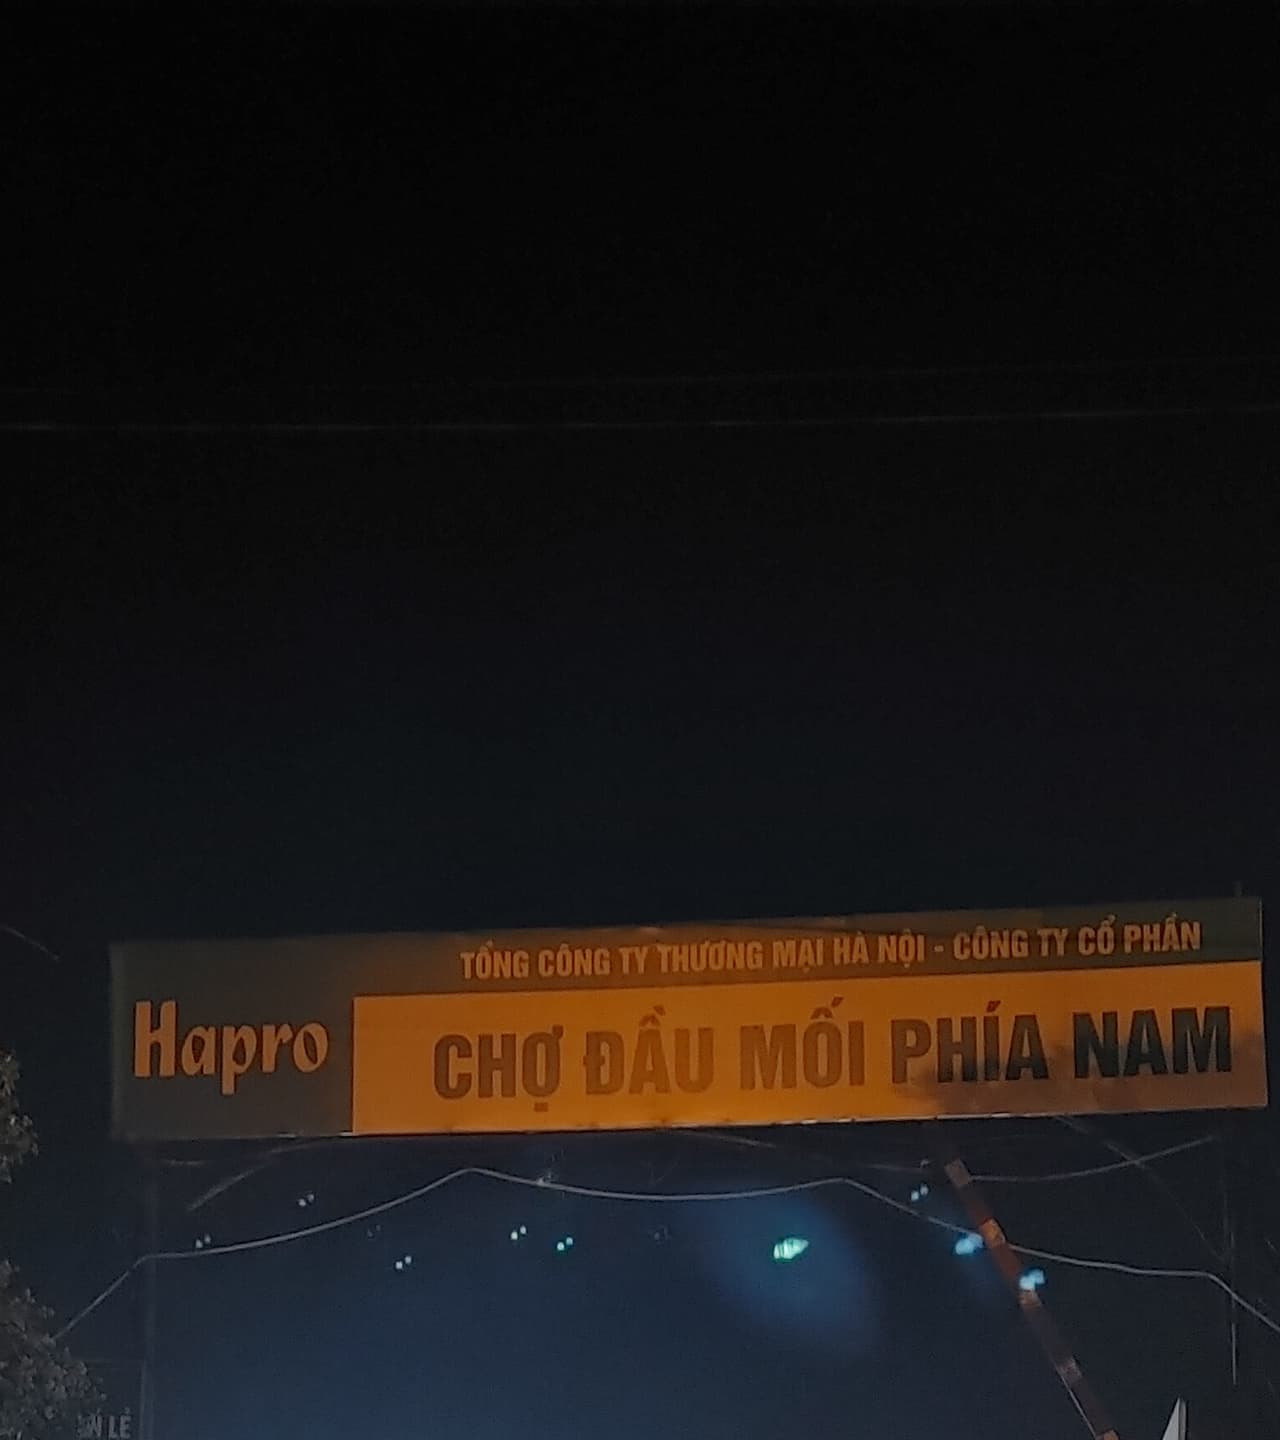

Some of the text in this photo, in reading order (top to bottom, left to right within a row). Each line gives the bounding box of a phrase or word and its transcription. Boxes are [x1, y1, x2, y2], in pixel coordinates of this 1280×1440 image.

[460, 938, 529, 980] TỔNG
[537, 942, 610, 977] CÔNG
[619, 944, 649, 975] TY
[652, 937, 763, 972] THƯƠNG
[772, 937, 823, 973] MẠI
[833, 930, 873, 966] HÀ
[878, 931, 926, 969] NỘI
[953, 924, 1029, 961] CÔNG
[1038, 926, 1070, 957] TY
[1077, 913, 1119, 956] CỔ
[1123, 910, 1202, 953] PHẦN
[132, 999, 330, 1096] Hapro
[433, 996, 1232, 1113] CHỢ ĐẦU MỐI PHÍA NAM
